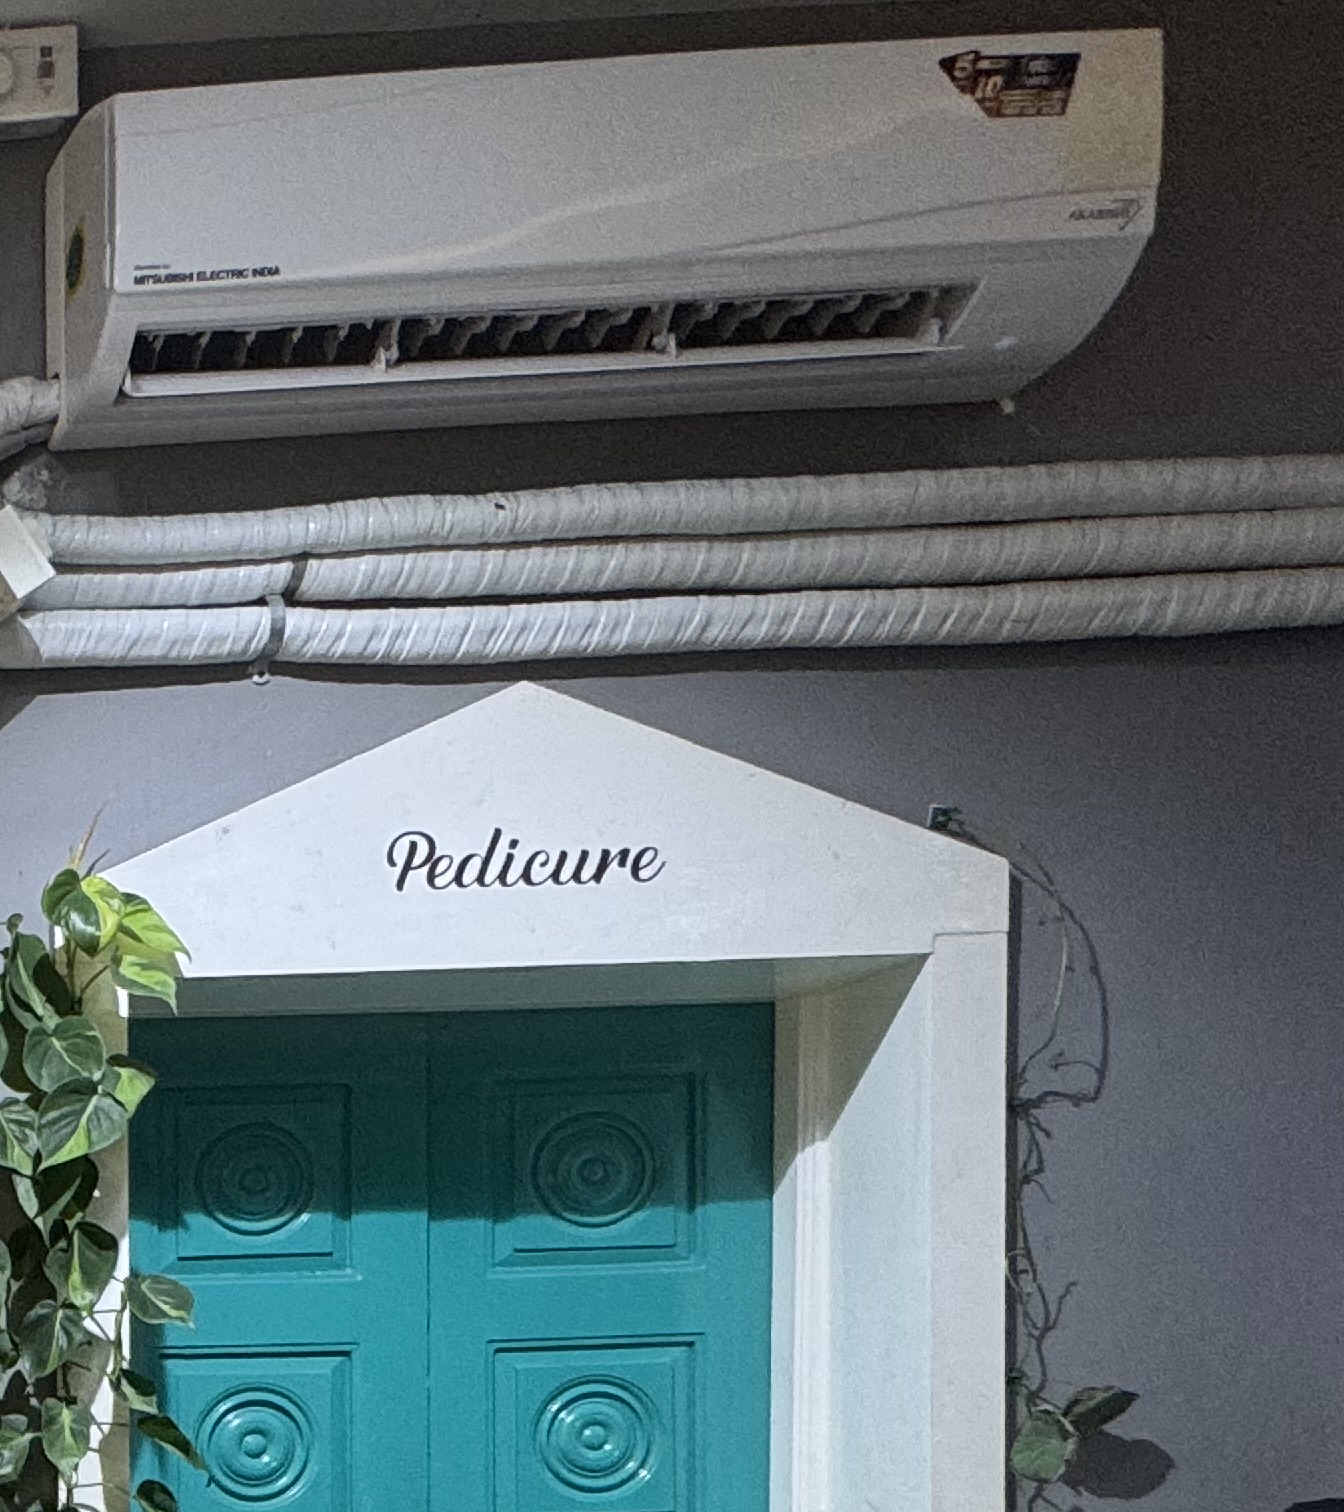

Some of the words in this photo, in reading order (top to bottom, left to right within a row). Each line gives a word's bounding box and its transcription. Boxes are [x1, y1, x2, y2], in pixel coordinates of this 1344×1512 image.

[133, 271, 194, 286] MITSUBISHI
[196, 268, 250, 282] ELECTRIC
[251, 264, 282, 278] INDIA
[386, 826, 667, 892] Pedicure
